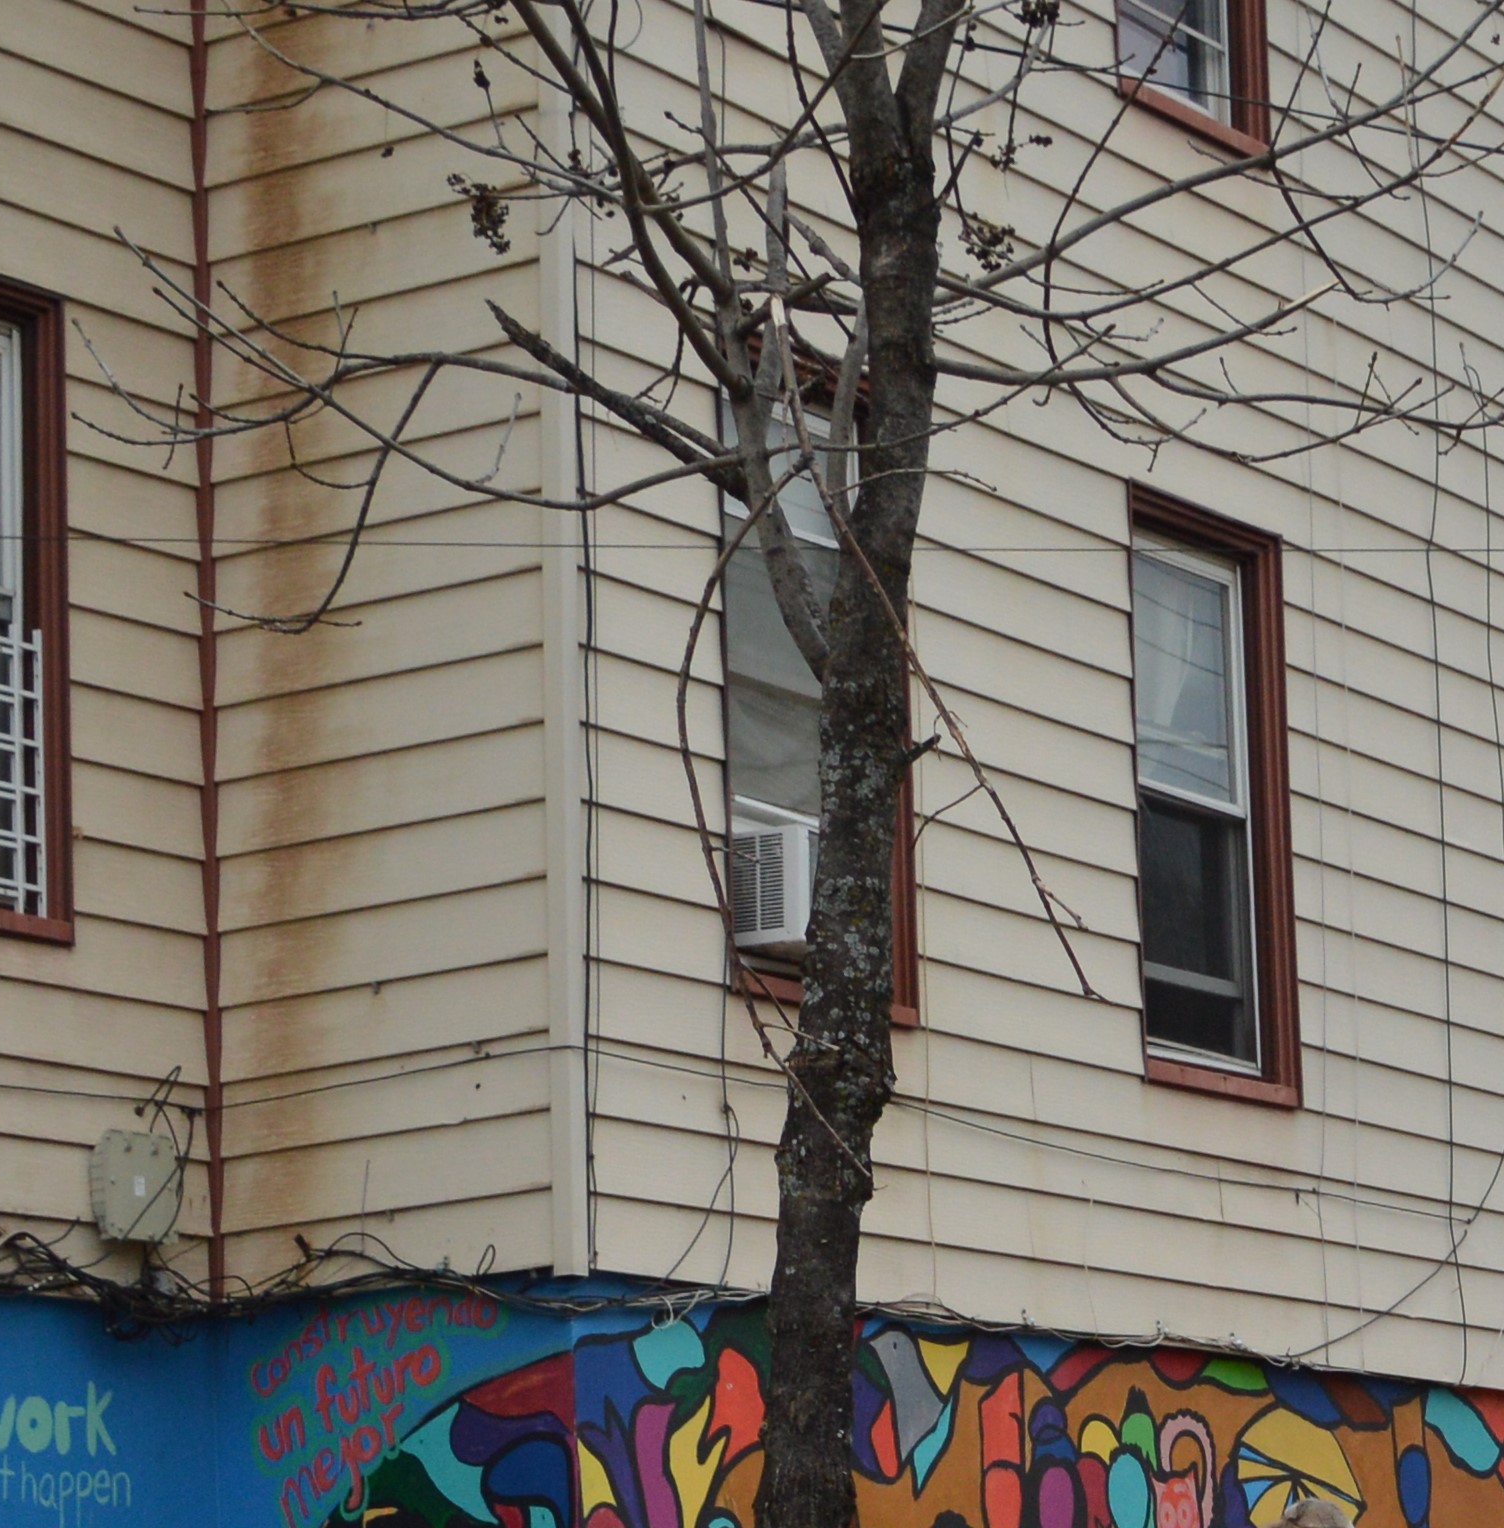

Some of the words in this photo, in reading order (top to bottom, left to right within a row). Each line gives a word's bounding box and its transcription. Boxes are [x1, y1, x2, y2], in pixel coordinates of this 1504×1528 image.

[251, 1293, 498, 1397] construyendo
[259, 1405, 305, 1461] un
[315, 1344, 442, 1433] futuro
